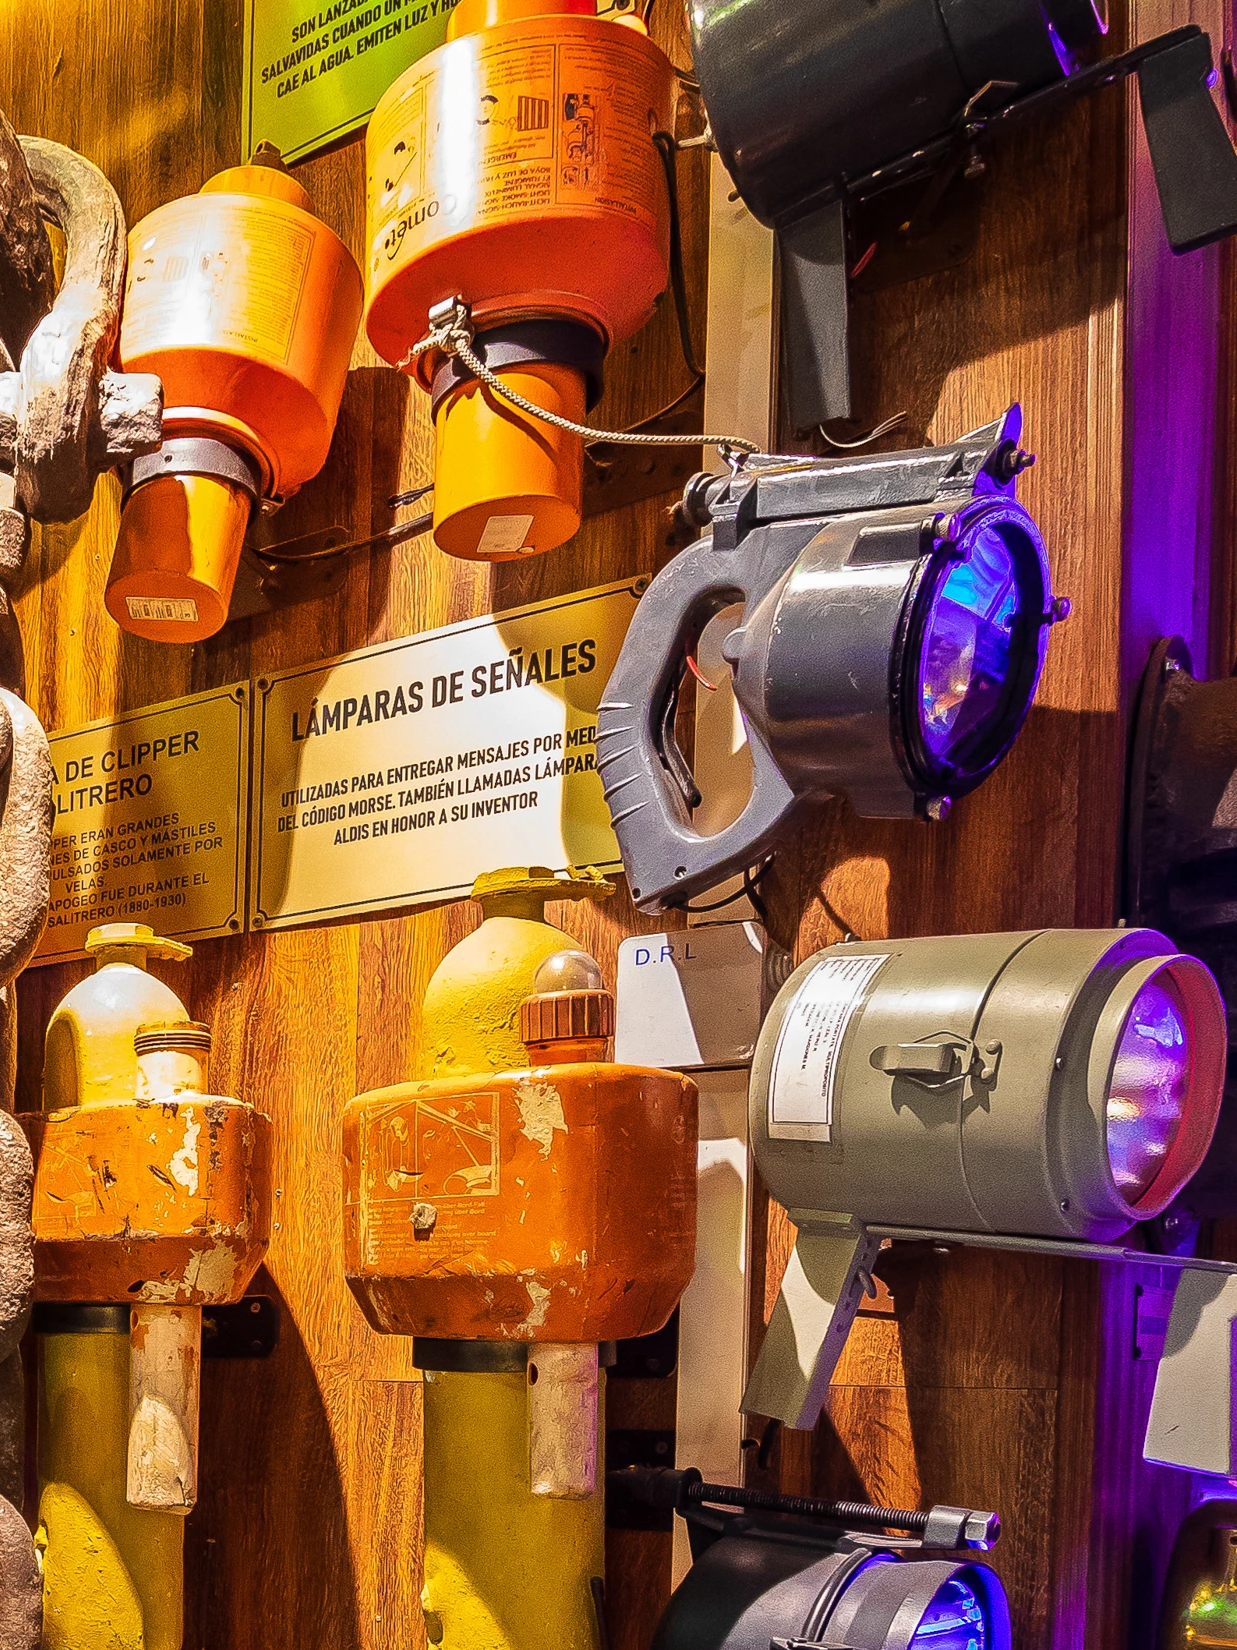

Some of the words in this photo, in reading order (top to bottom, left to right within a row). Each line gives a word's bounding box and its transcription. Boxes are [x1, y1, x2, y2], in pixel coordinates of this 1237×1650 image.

[261, 34, 329, 84] SALVAVIDAS
[332, 9, 382, 44] CUANDO
[384, 0, 403, 16] UN
[276, 73, 300, 98] CAE
[301, 65, 318, 86] AL
[318, 46, 354, 76] AGUA.
[356, 18, 403, 55] EMITEN
[404, 5, 429, 31] LUZ
[429, 0, 439, 17] Y
[291, 16, 316, 43] SON
[291, 681, 424, 742] LÁMPARAS
[432, 670, 465, 708] DE
[471, 639, 597, 698] SEÑALES
[65, 755, 94, 783] DE
[101, 730, 200, 773] CLIPPER
[281, 778, 349, 808] UTILIZADAS
[351, 770, 385, 794] PARA
[387, 757, 454, 786] ENTREGAR
[457, 740, 529, 771] MENSAJES
[533, 733, 562, 753] POR
[566, 725, 597, 747] MED
[56, 774, 153, 815] LITRERO
[277, 814, 299, 833] DEL
[302, 803, 347, 827] CÓDIGO
[348, 795, 396, 819] MORSE.
[398, 778, 455, 808] TAMBIÉN
[457, 765, 531, 795] LLAMADAS
[535, 753, 598, 780] LÁMPARA
[80, 828, 114, 844] ERAN
[117, 812, 180, 835] GRANDES
[334, 821, 370, 846] ALDIS
[372, 818, 389, 838] EN
[391, 810, 435, 834] HONOR
[438, 808, 449, 825] A
[451, 803, 470, 821] SU
[471, 791, 539, 819] INVENTOR
[73, 845, 89, 860] DE
[93, 836, 137, 857] CASCO
[140, 833, 149, 846] Y
[151, 821, 217, 845] MÁSTILES
[112, 843, 190, 868] SOLAMENTE
[195, 836, 223, 852] POR
[48, 892, 98, 912] APOGEO
[101, 887, 125, 901] FUE
[128, 875, 190, 898] DURANTE
[193, 872, 210, 886] EL
[65, 876, 108, 894] VELAS.
[48, 905, 115, 928] SALITRERO
[117, 893, 187, 917] (1880-1930)
[635, 943, 697, 966] D.R.L
